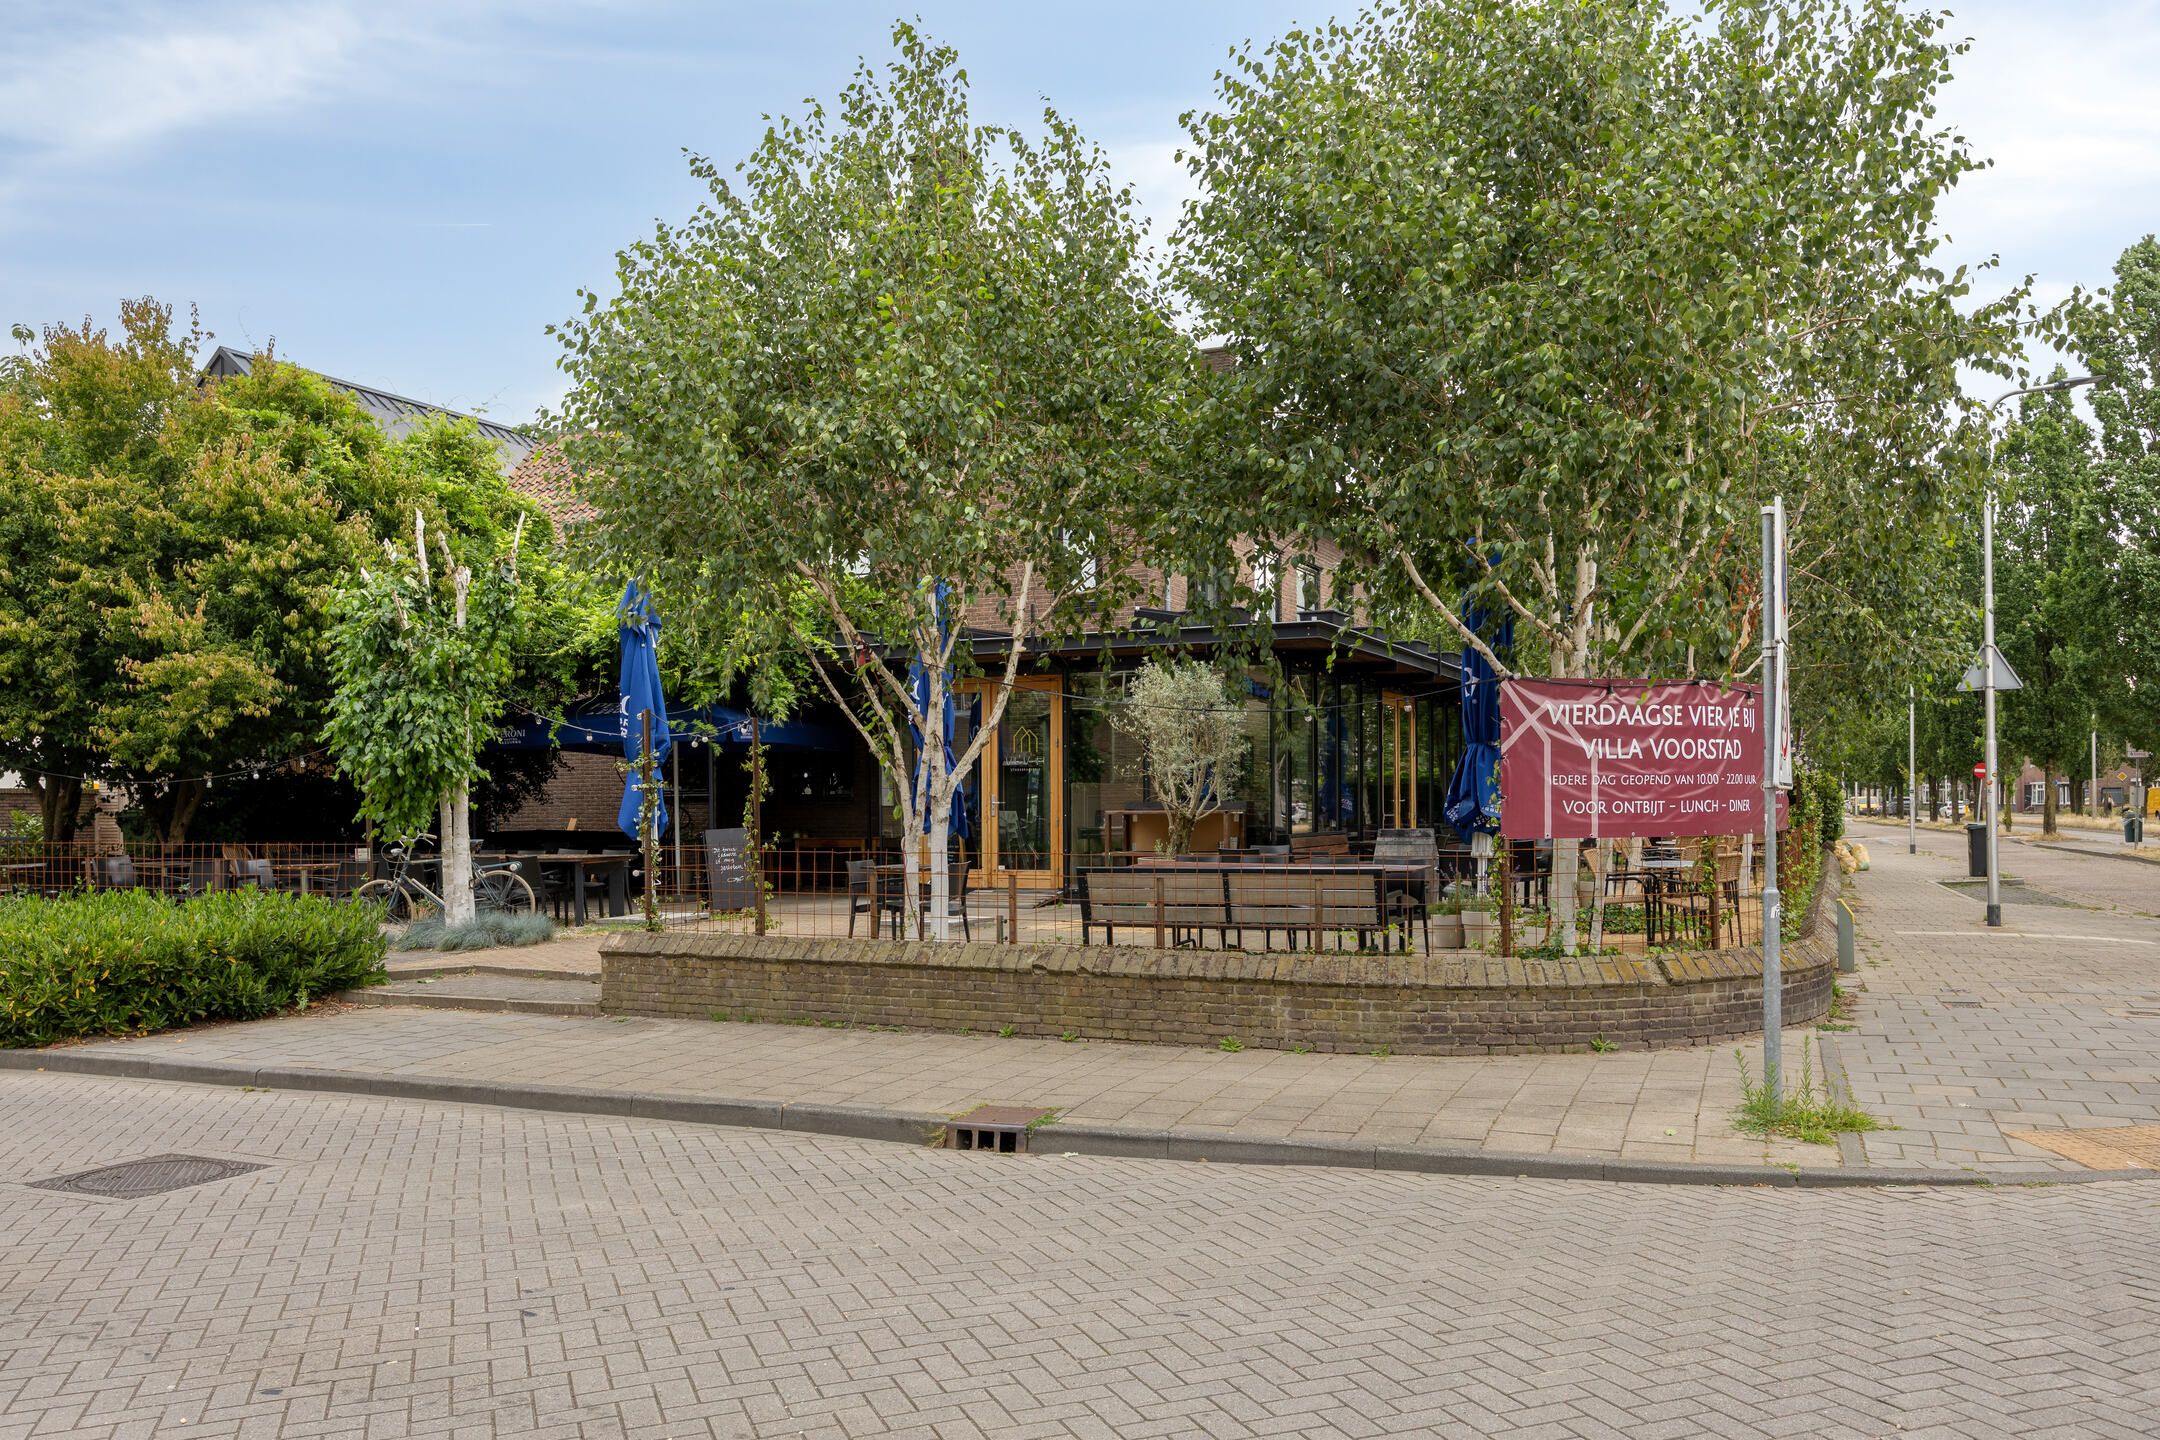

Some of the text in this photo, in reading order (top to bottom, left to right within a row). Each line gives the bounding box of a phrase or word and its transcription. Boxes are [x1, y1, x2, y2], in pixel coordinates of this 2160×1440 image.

[1546, 703, 1683, 726] VIERDAAGSE
[1688, 705, 1726, 727] VIER
[1728, 706, 1740, 732] JE
[1743, 707, 1755, 733] BIJ
[1580, 738, 1742, 760] VILLA VOORSTAD
[1549, 774, 1588, 786] IEDERE
[1592, 774, 1616, 786] DAG
[1621, 774, 1671, 786] GEOPEND
[1674, 774, 1694, 785] VAN
[1696, 773, 1719, 785] 10.00
[1744, 774, 1757, 785] UUR
[1562, 800, 1608, 814] VOOR
[1612, 800, 1666, 817] ONTBIJT
[1680, 799, 1719, 813] LUNCH
[1729, 799, 1751, 812] DINER
